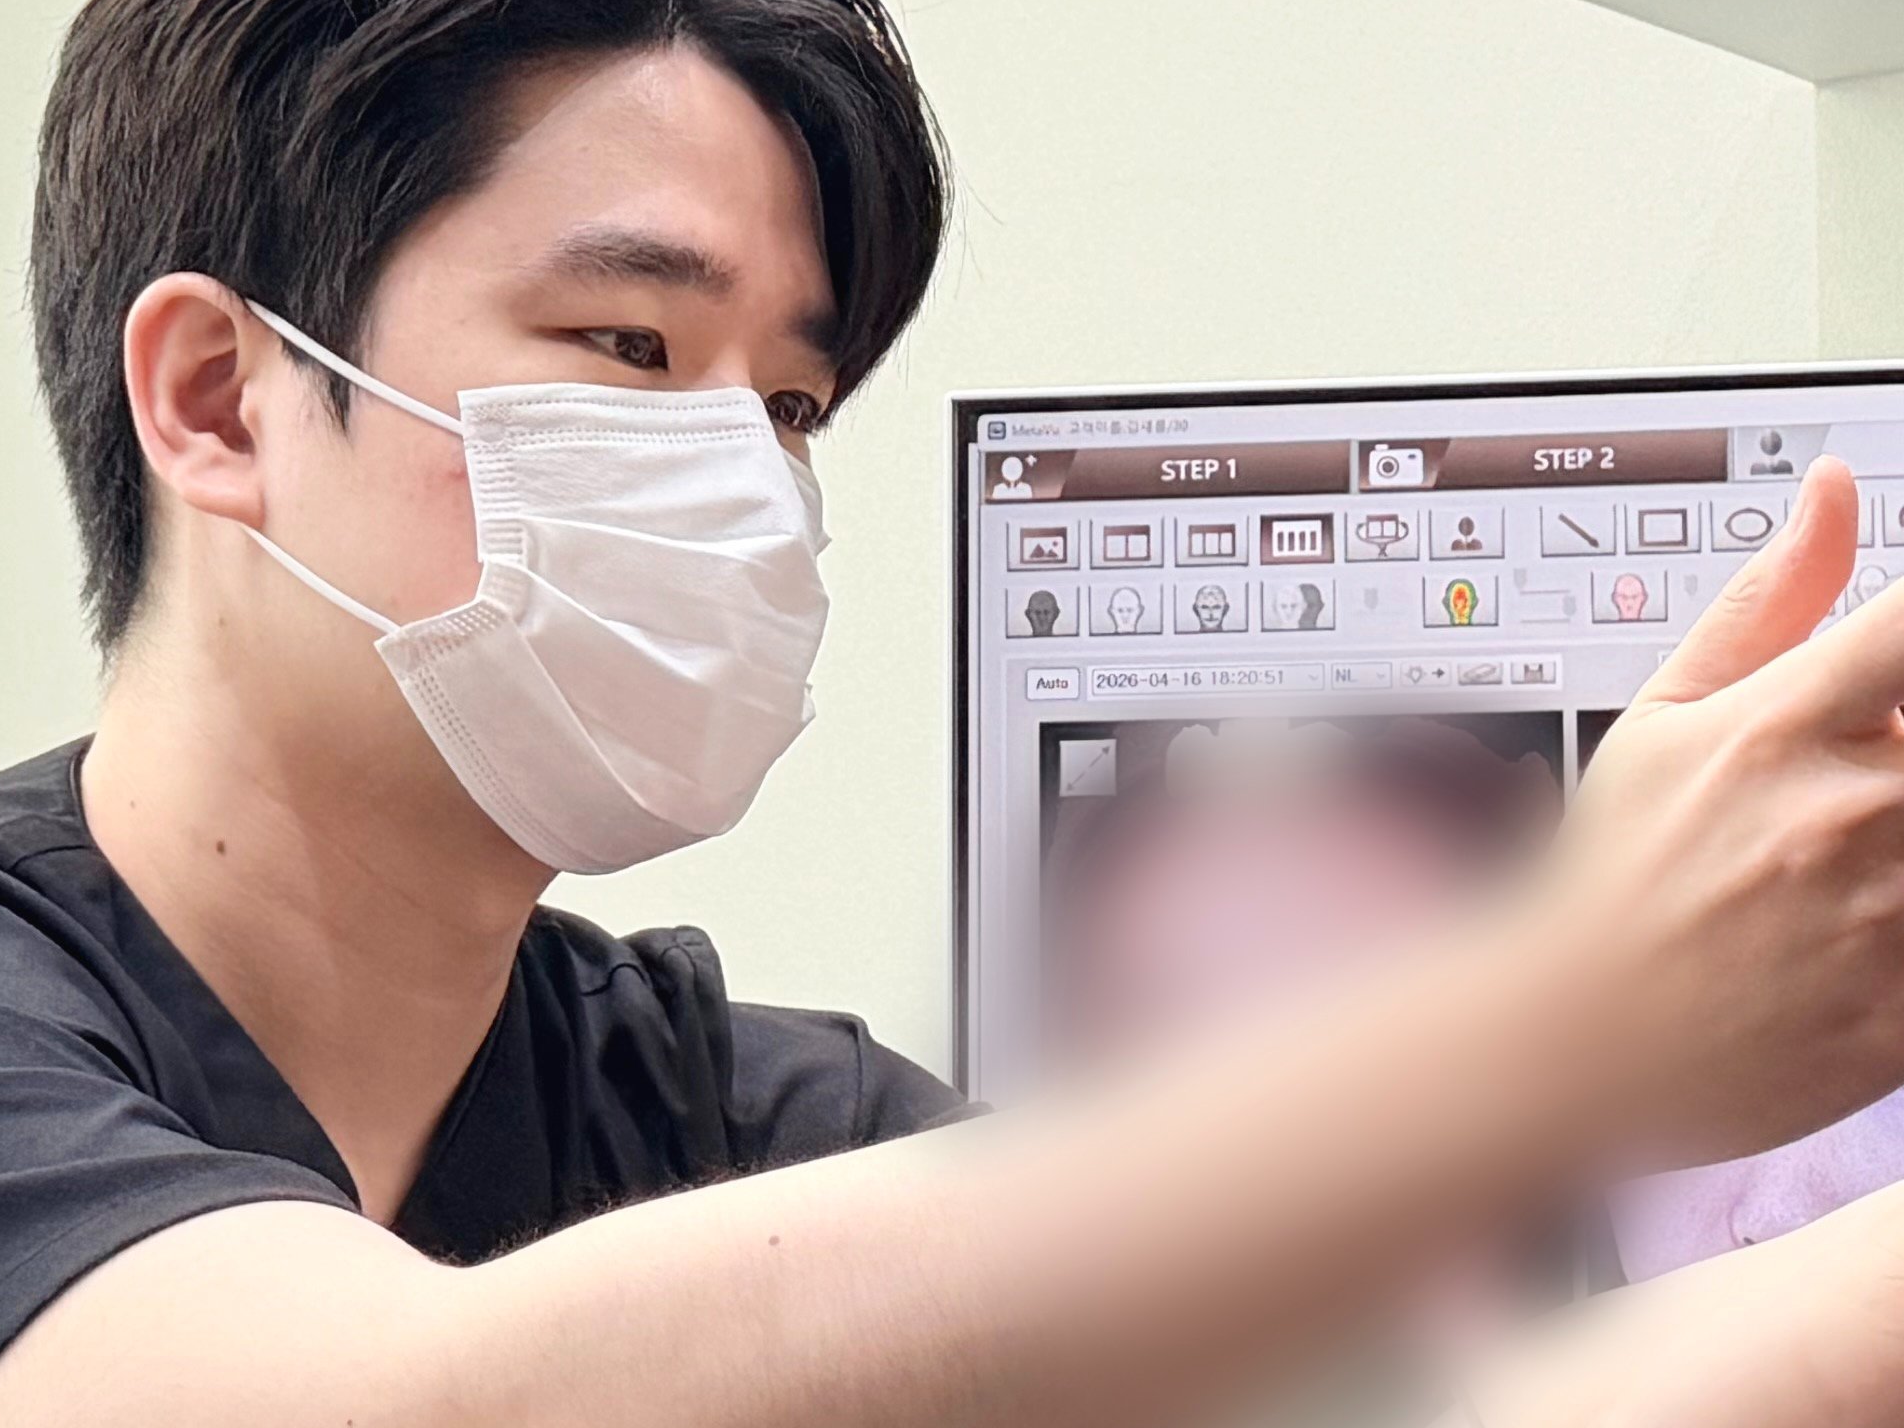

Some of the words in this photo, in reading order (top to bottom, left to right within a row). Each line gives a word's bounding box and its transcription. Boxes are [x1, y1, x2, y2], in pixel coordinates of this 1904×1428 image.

[1160, 460, 1221, 482] STEP
[1227, 458, 1237, 480] 1
[1533, 448, 1593, 471] STEP
[1598, 447, 1616, 469] 2
[1035, 676, 1069, 690] Auto
[1095, 670, 1203, 690] 2026-04-16
[1209, 669, 1286, 686] 18:20:51
